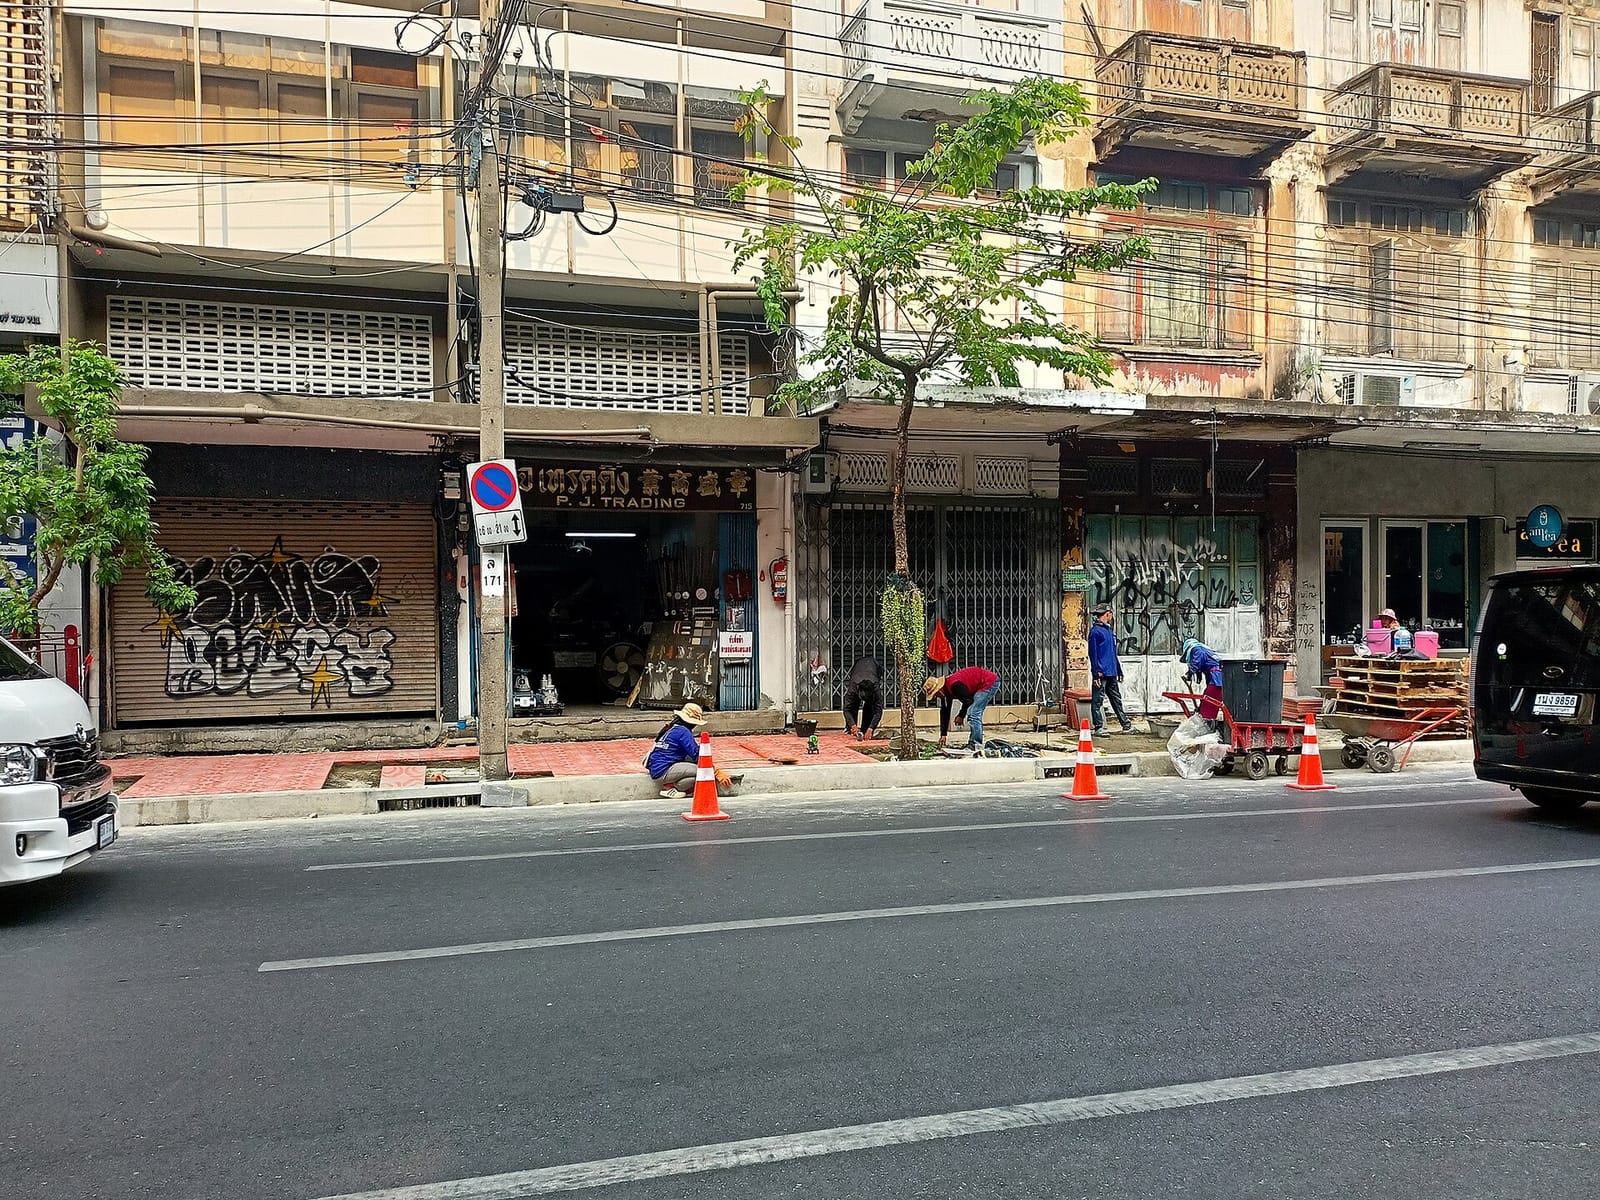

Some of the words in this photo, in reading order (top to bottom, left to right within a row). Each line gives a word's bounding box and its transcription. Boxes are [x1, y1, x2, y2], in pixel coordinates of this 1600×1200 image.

[556, 495, 573, 506] P.
[579, 496, 596, 507] J.
[600, 497, 686, 509] TRADING
[484, 575, 501, 586] 171
[1554, 696, 1576, 706] 9856
